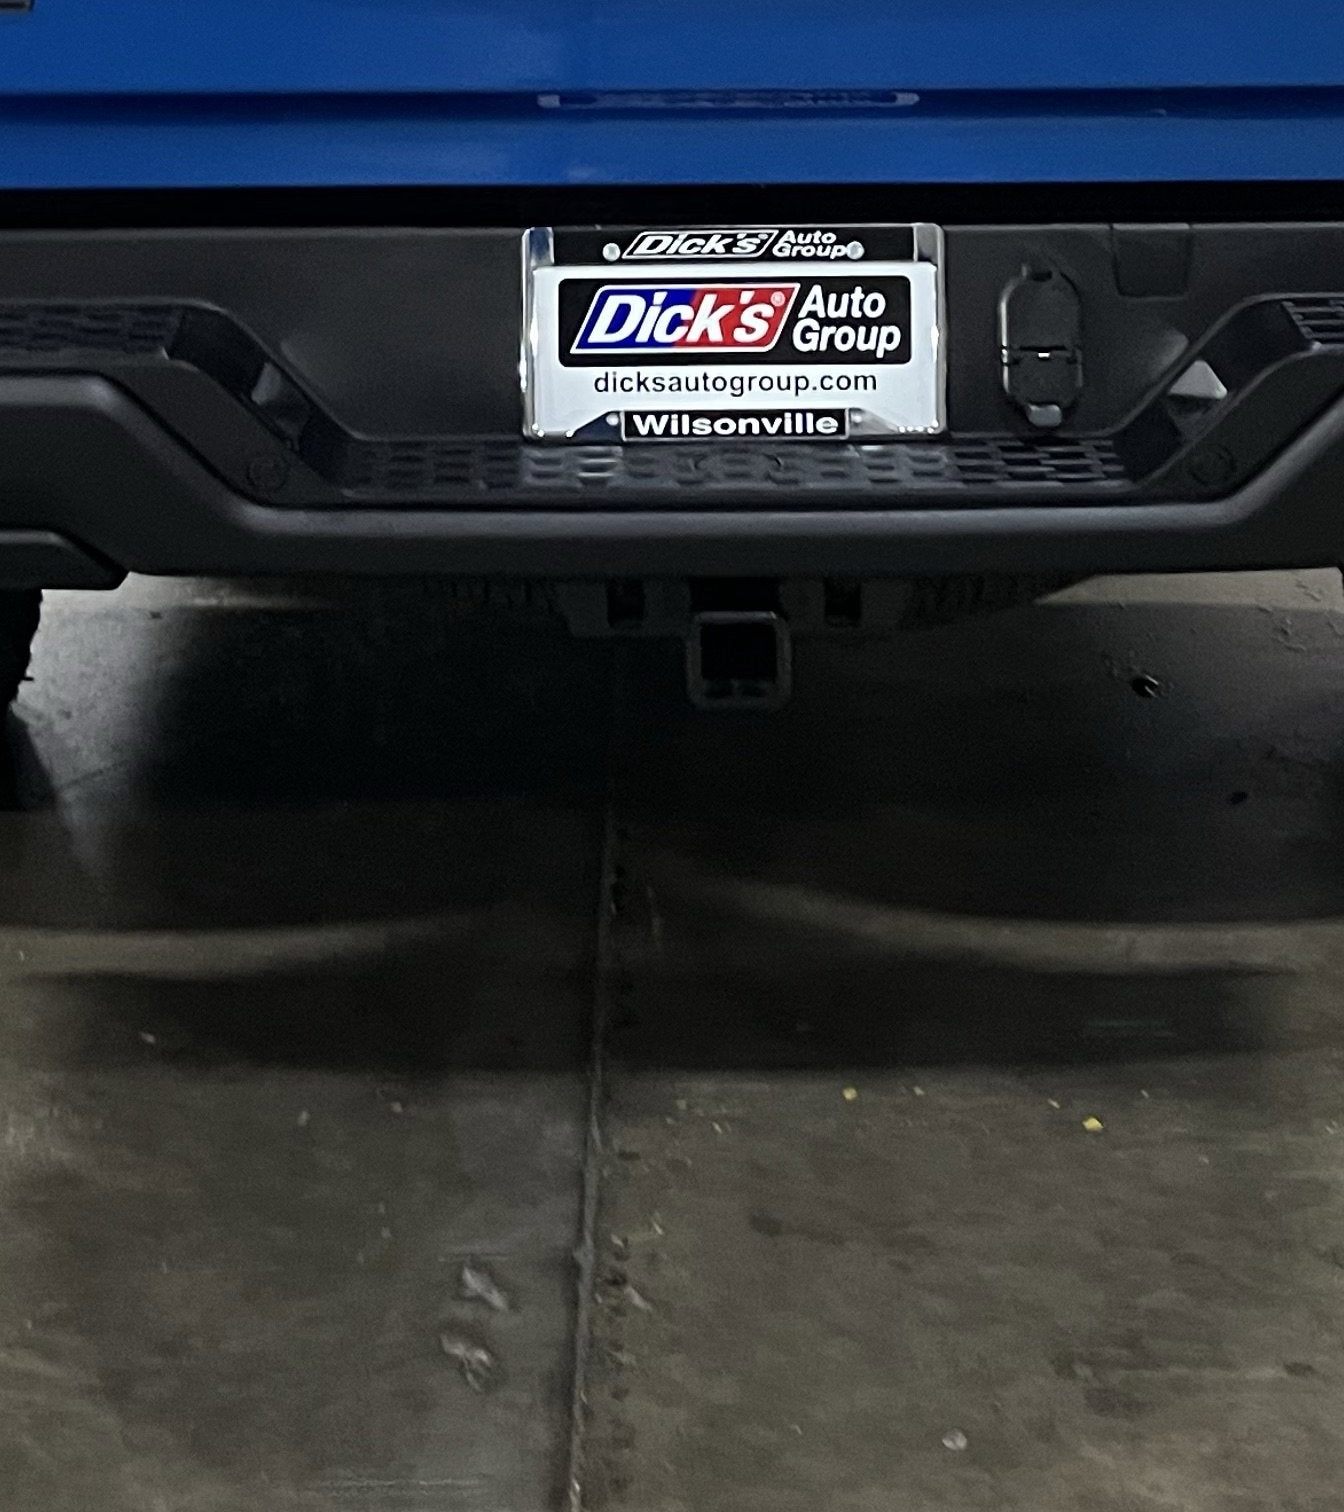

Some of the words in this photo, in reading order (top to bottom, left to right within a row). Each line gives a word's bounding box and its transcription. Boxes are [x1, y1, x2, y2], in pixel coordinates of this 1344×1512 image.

[776, 230, 837, 244] Auto
[772, 242, 848, 259] Group
[798, 285, 886, 319] Auto
[792, 319, 901, 358] Group
[594, 371, 878, 397] dicksautogroup.com
[632, 412, 839, 436] Wilsonville
